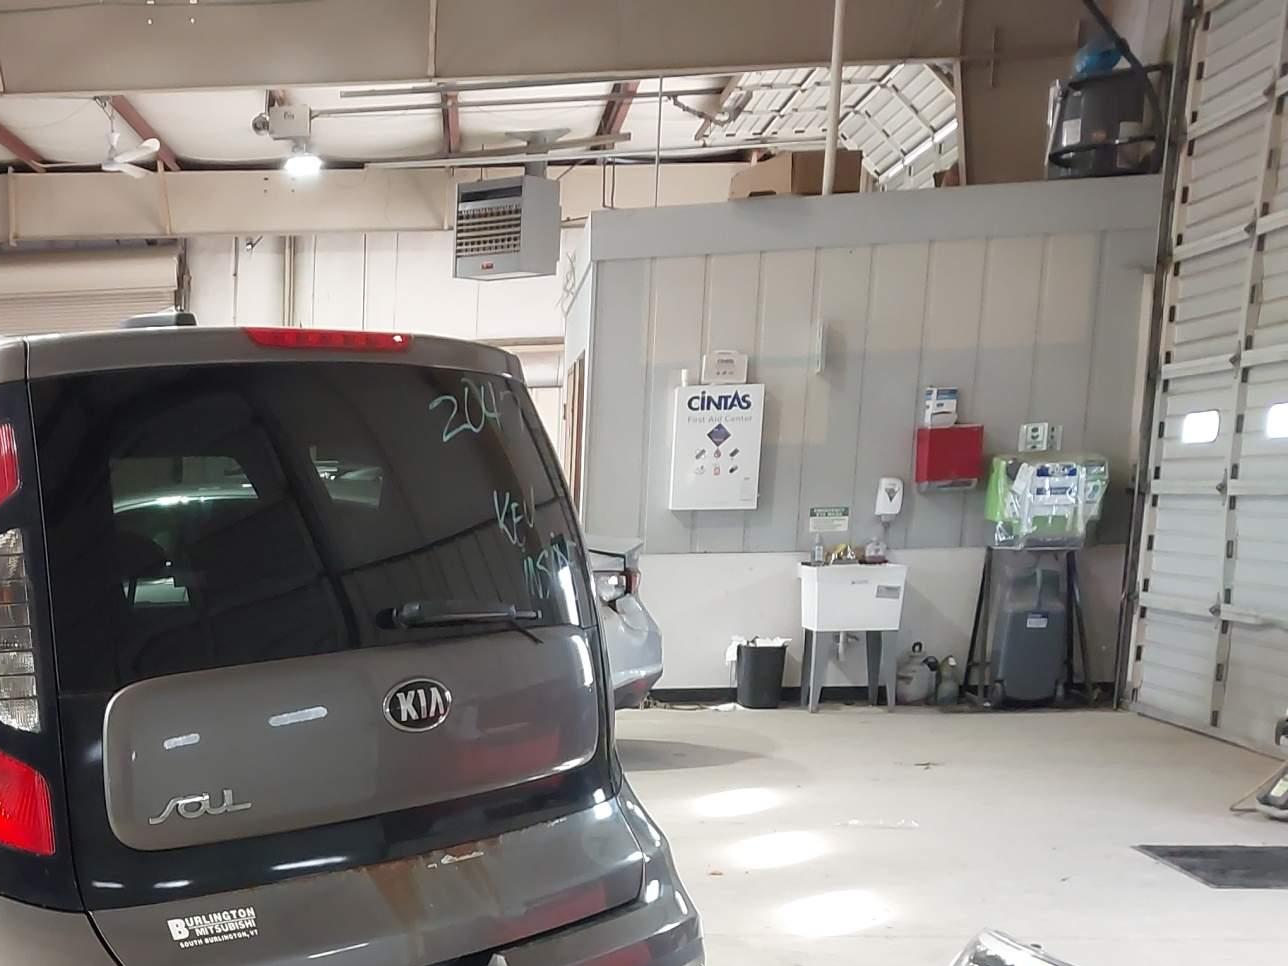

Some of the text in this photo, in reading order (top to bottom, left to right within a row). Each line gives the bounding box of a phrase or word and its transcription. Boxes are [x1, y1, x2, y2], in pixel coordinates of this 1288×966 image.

[687, 415, 706, 424] First
[725, 414, 752, 423] Center
[396, 687, 445, 721] KIA
[167, 907, 256, 940] BURLINGTON
[195, 919, 256, 937] MITSUBISHI
[179, 928, 258, 948] SOUTH BURLINGTON, VT
